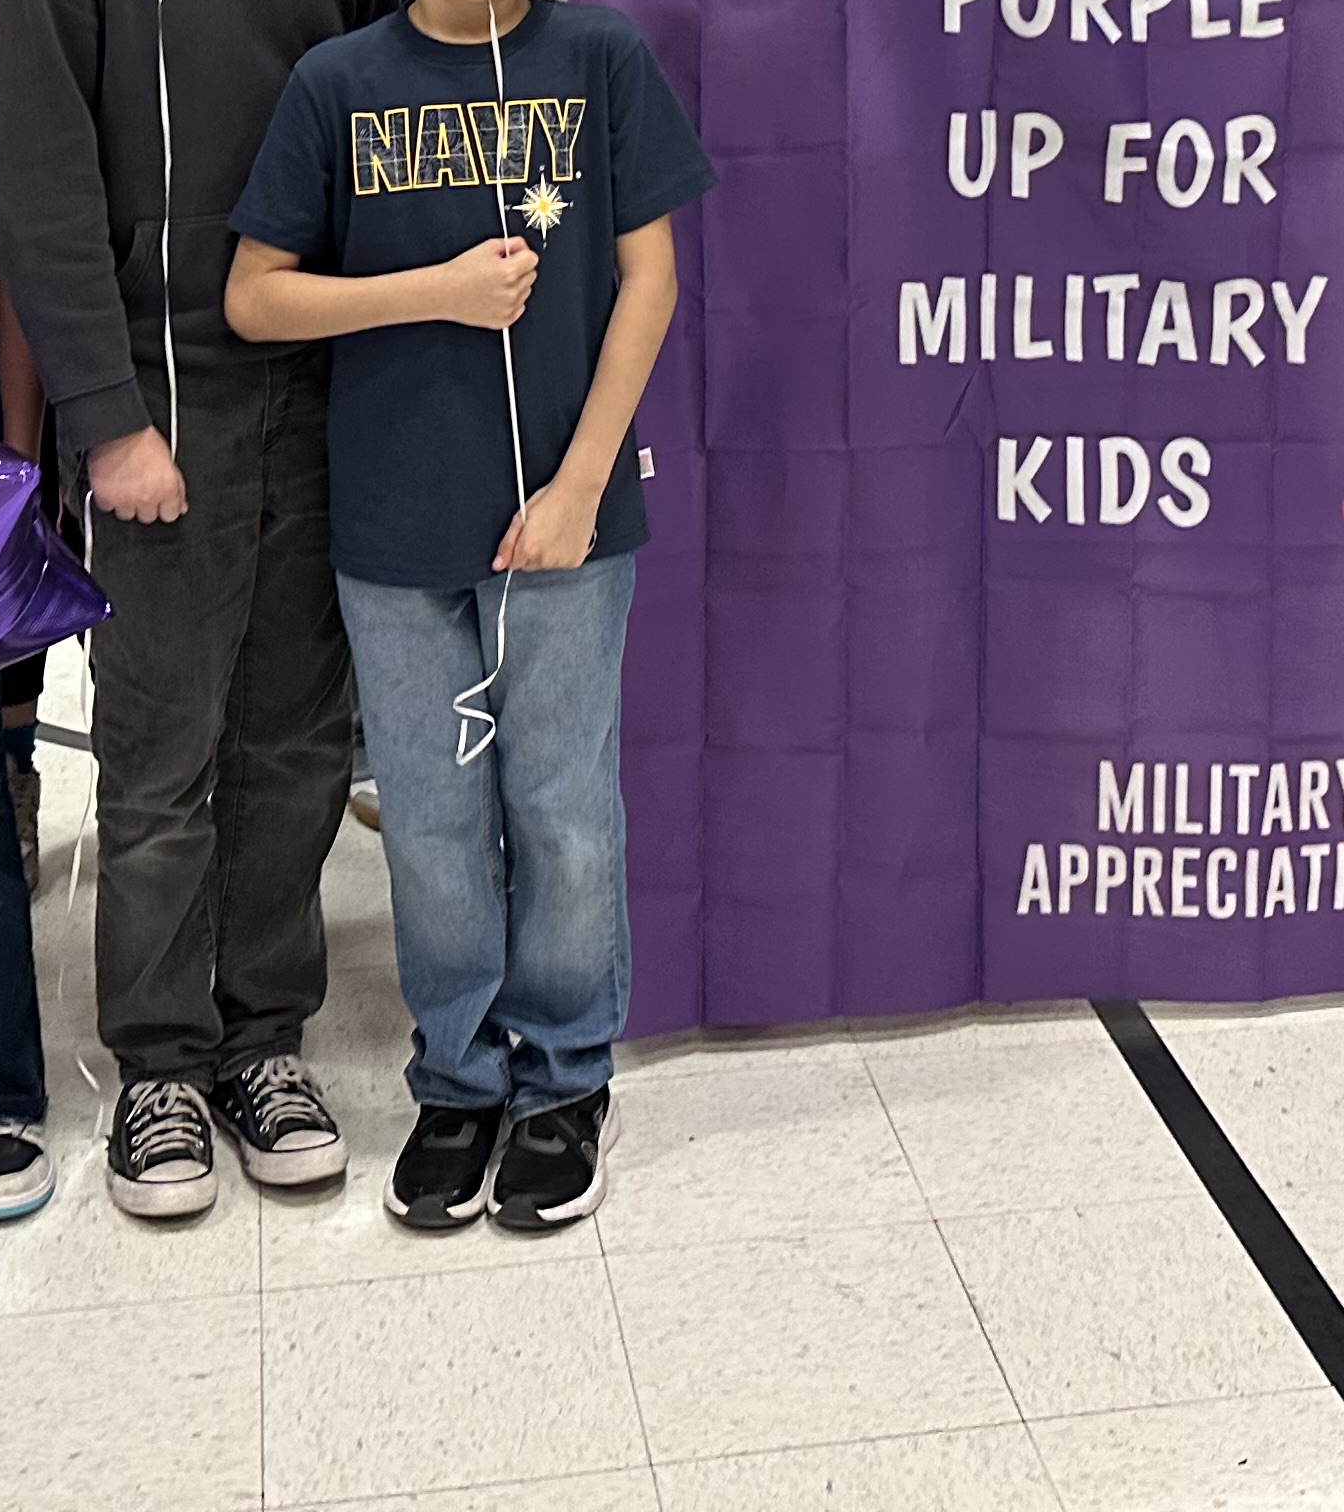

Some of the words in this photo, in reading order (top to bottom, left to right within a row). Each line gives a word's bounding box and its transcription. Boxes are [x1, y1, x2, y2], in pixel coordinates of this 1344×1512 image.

[351, 99, 587, 196] NAVY
[947, 109, 1064, 199] UP
[1103, 114, 1278, 208] FOR
[898, 273, 1330, 367] MILITARY
[996, 436, 1212, 528] KIDS
